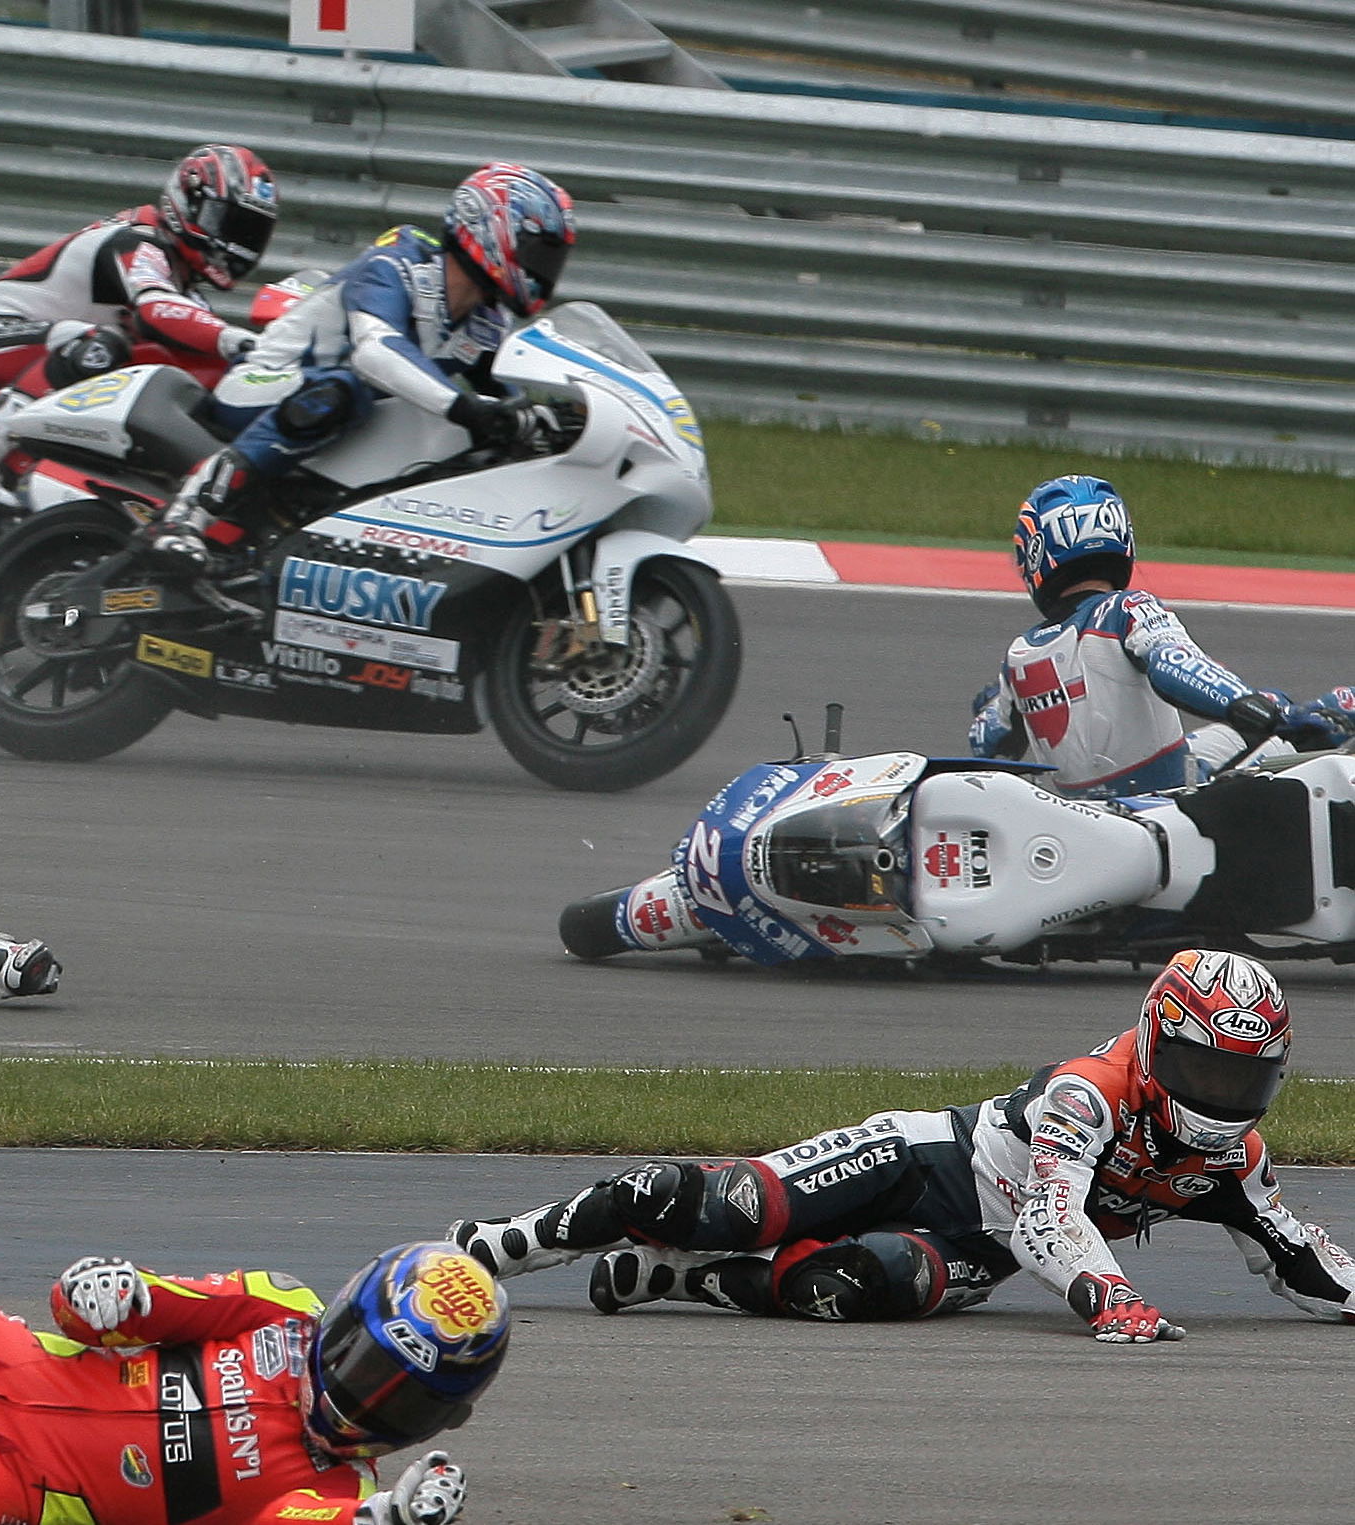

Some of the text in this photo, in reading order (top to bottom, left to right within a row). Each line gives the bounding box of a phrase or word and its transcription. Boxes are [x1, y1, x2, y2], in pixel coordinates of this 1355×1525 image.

[361, 525, 469, 559] RIZOMA
[278, 556, 448, 632] HUSKY
[260, 641, 341, 676] Vitillo
[1217, 1013, 1264, 1033] Arai
[793, 1142, 899, 1195] HONDA
[419, 1268, 486, 1327] Chups
[437, 1256, 494, 1312] Chupa
[161, 1371, 188, 1464] LOTUS
